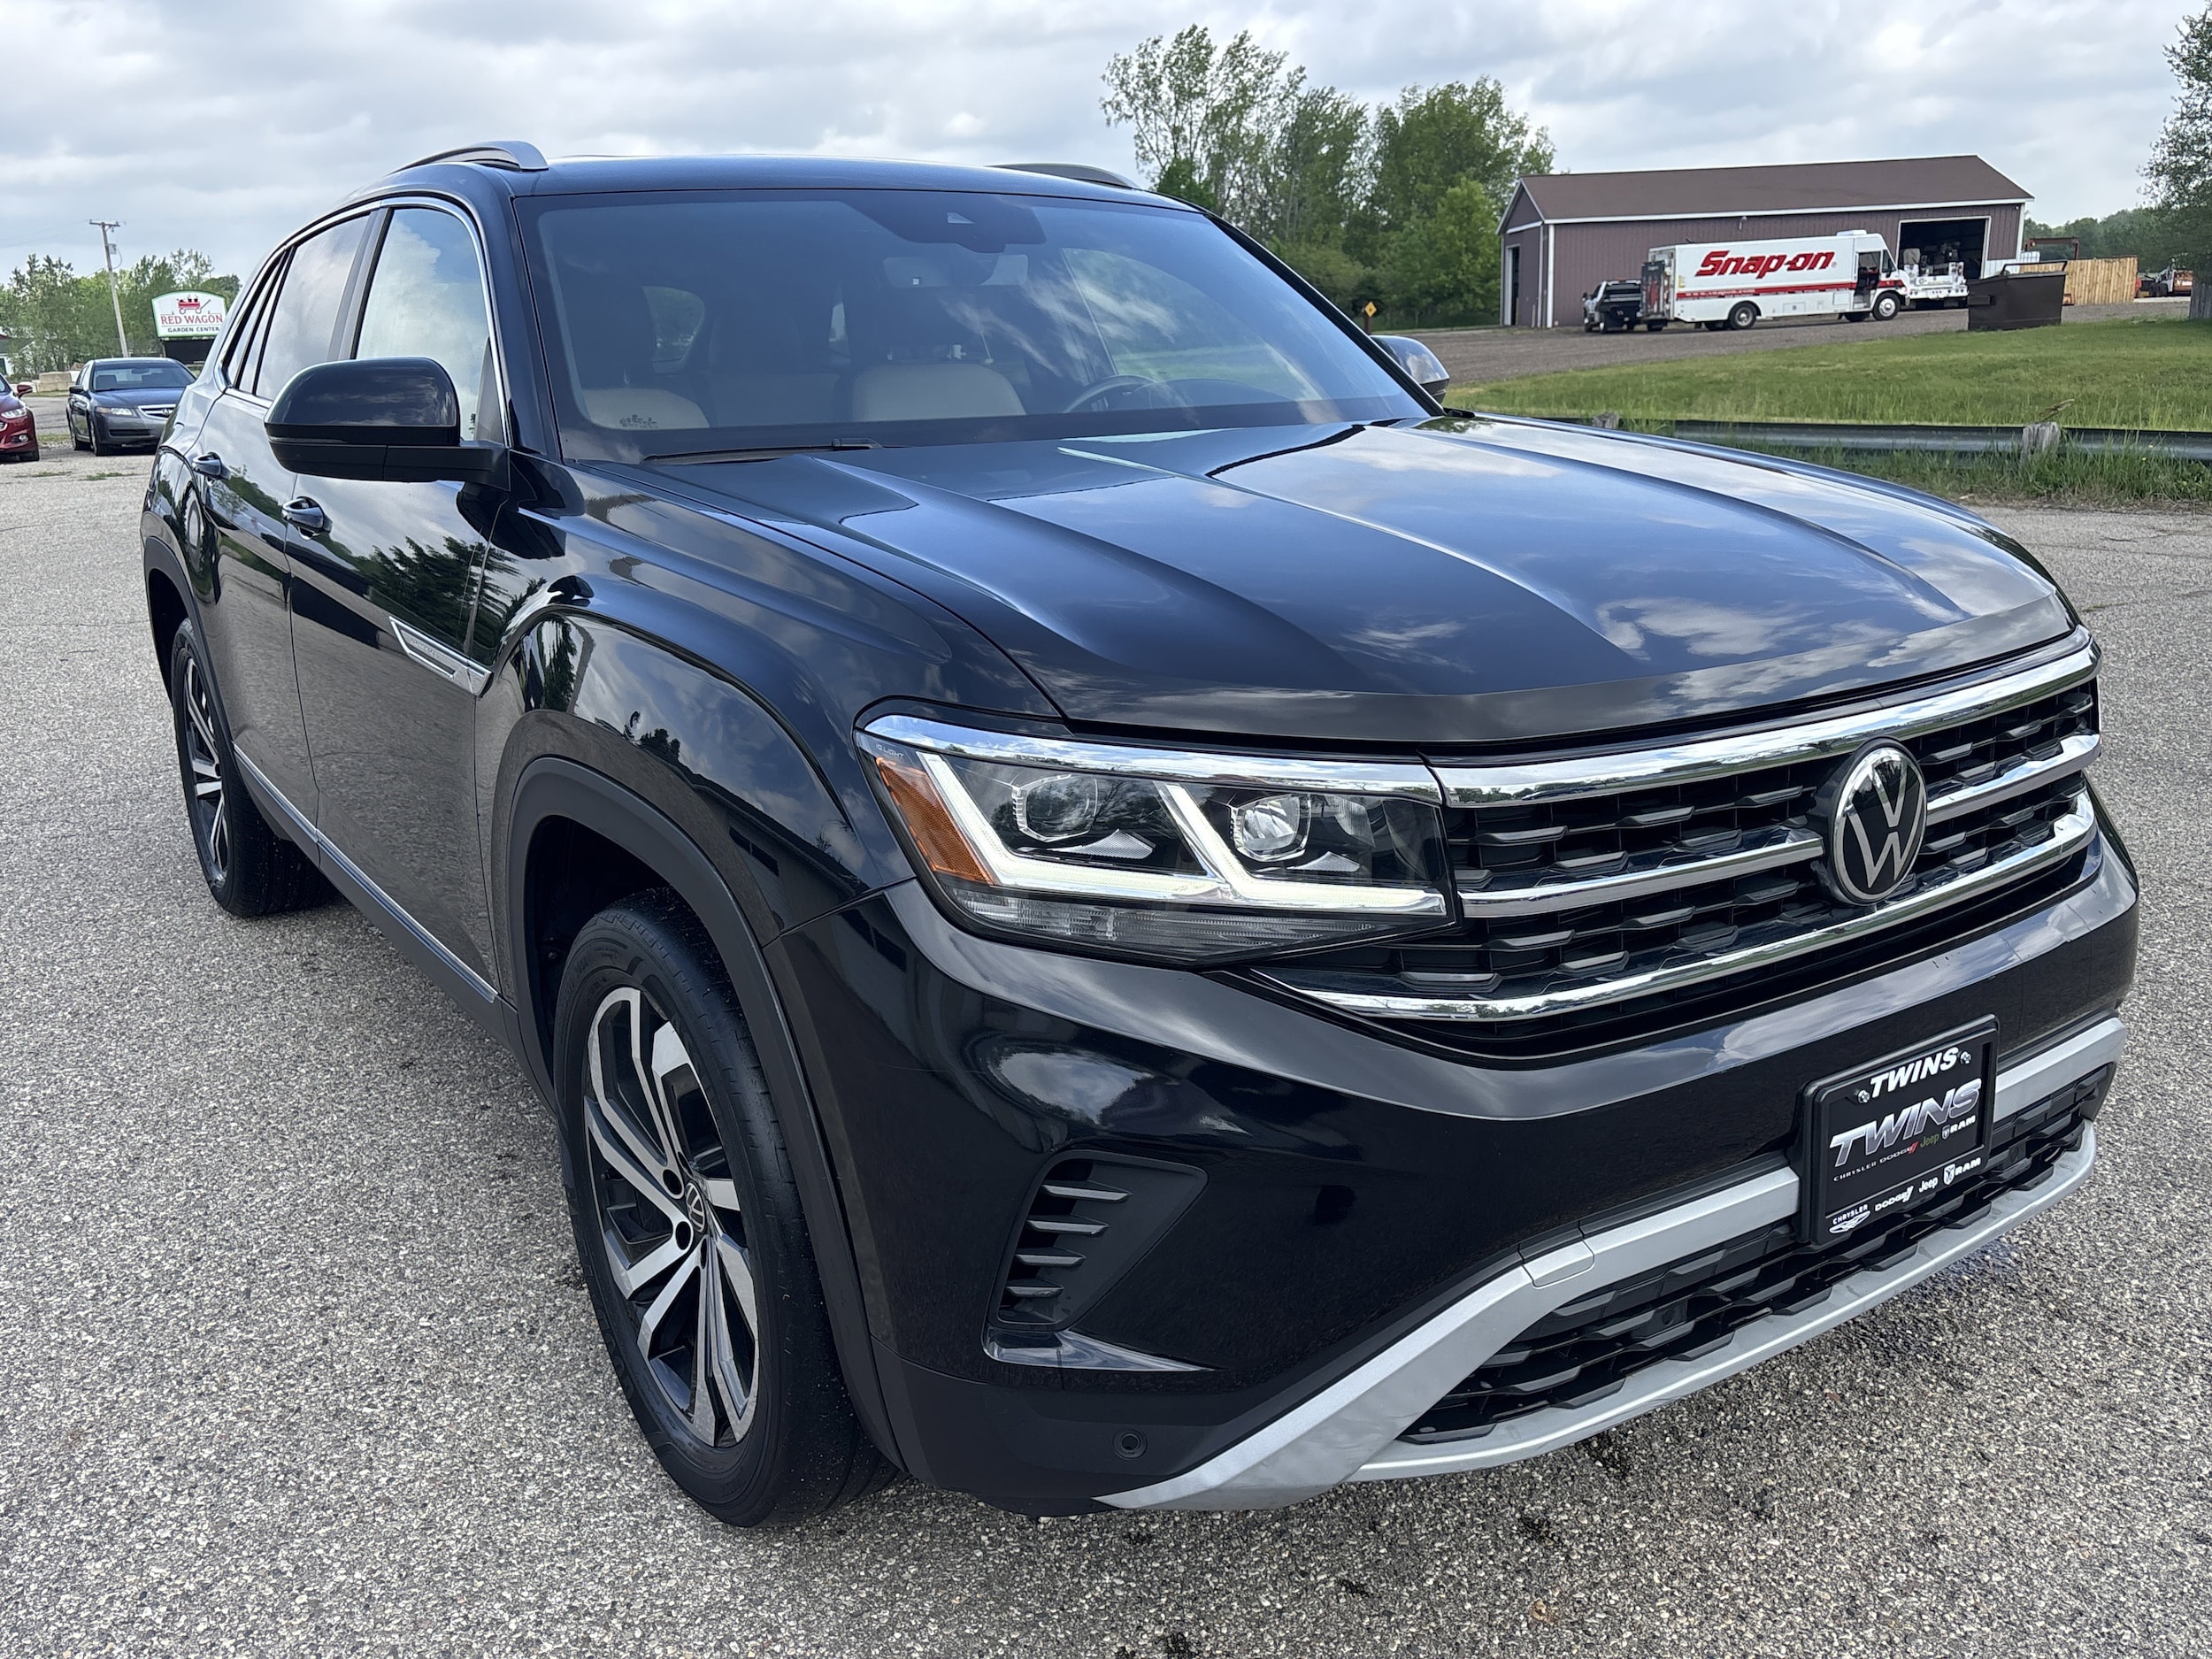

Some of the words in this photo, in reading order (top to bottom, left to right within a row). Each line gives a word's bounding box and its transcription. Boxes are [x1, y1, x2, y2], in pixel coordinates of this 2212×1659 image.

[1694, 250, 1835, 279] Snap-on
[160, 315, 182, 325] RED
[183, 314, 223, 324] WAGON
[1870, 1047, 1959, 1098] TWINS
[1829, 1078, 1982, 1167] TWINS
[1833, 1161, 1877, 1182] CHRYSLER
[1920, 1133, 1939, 1148] Jeep
[1950, 1115, 1976, 1133] RAM
[1832, 1204, 1868, 1225] CHRYSLER
[1918, 1177, 1939, 1193] Jeep
[1955, 1157, 1981, 1176] RAM
